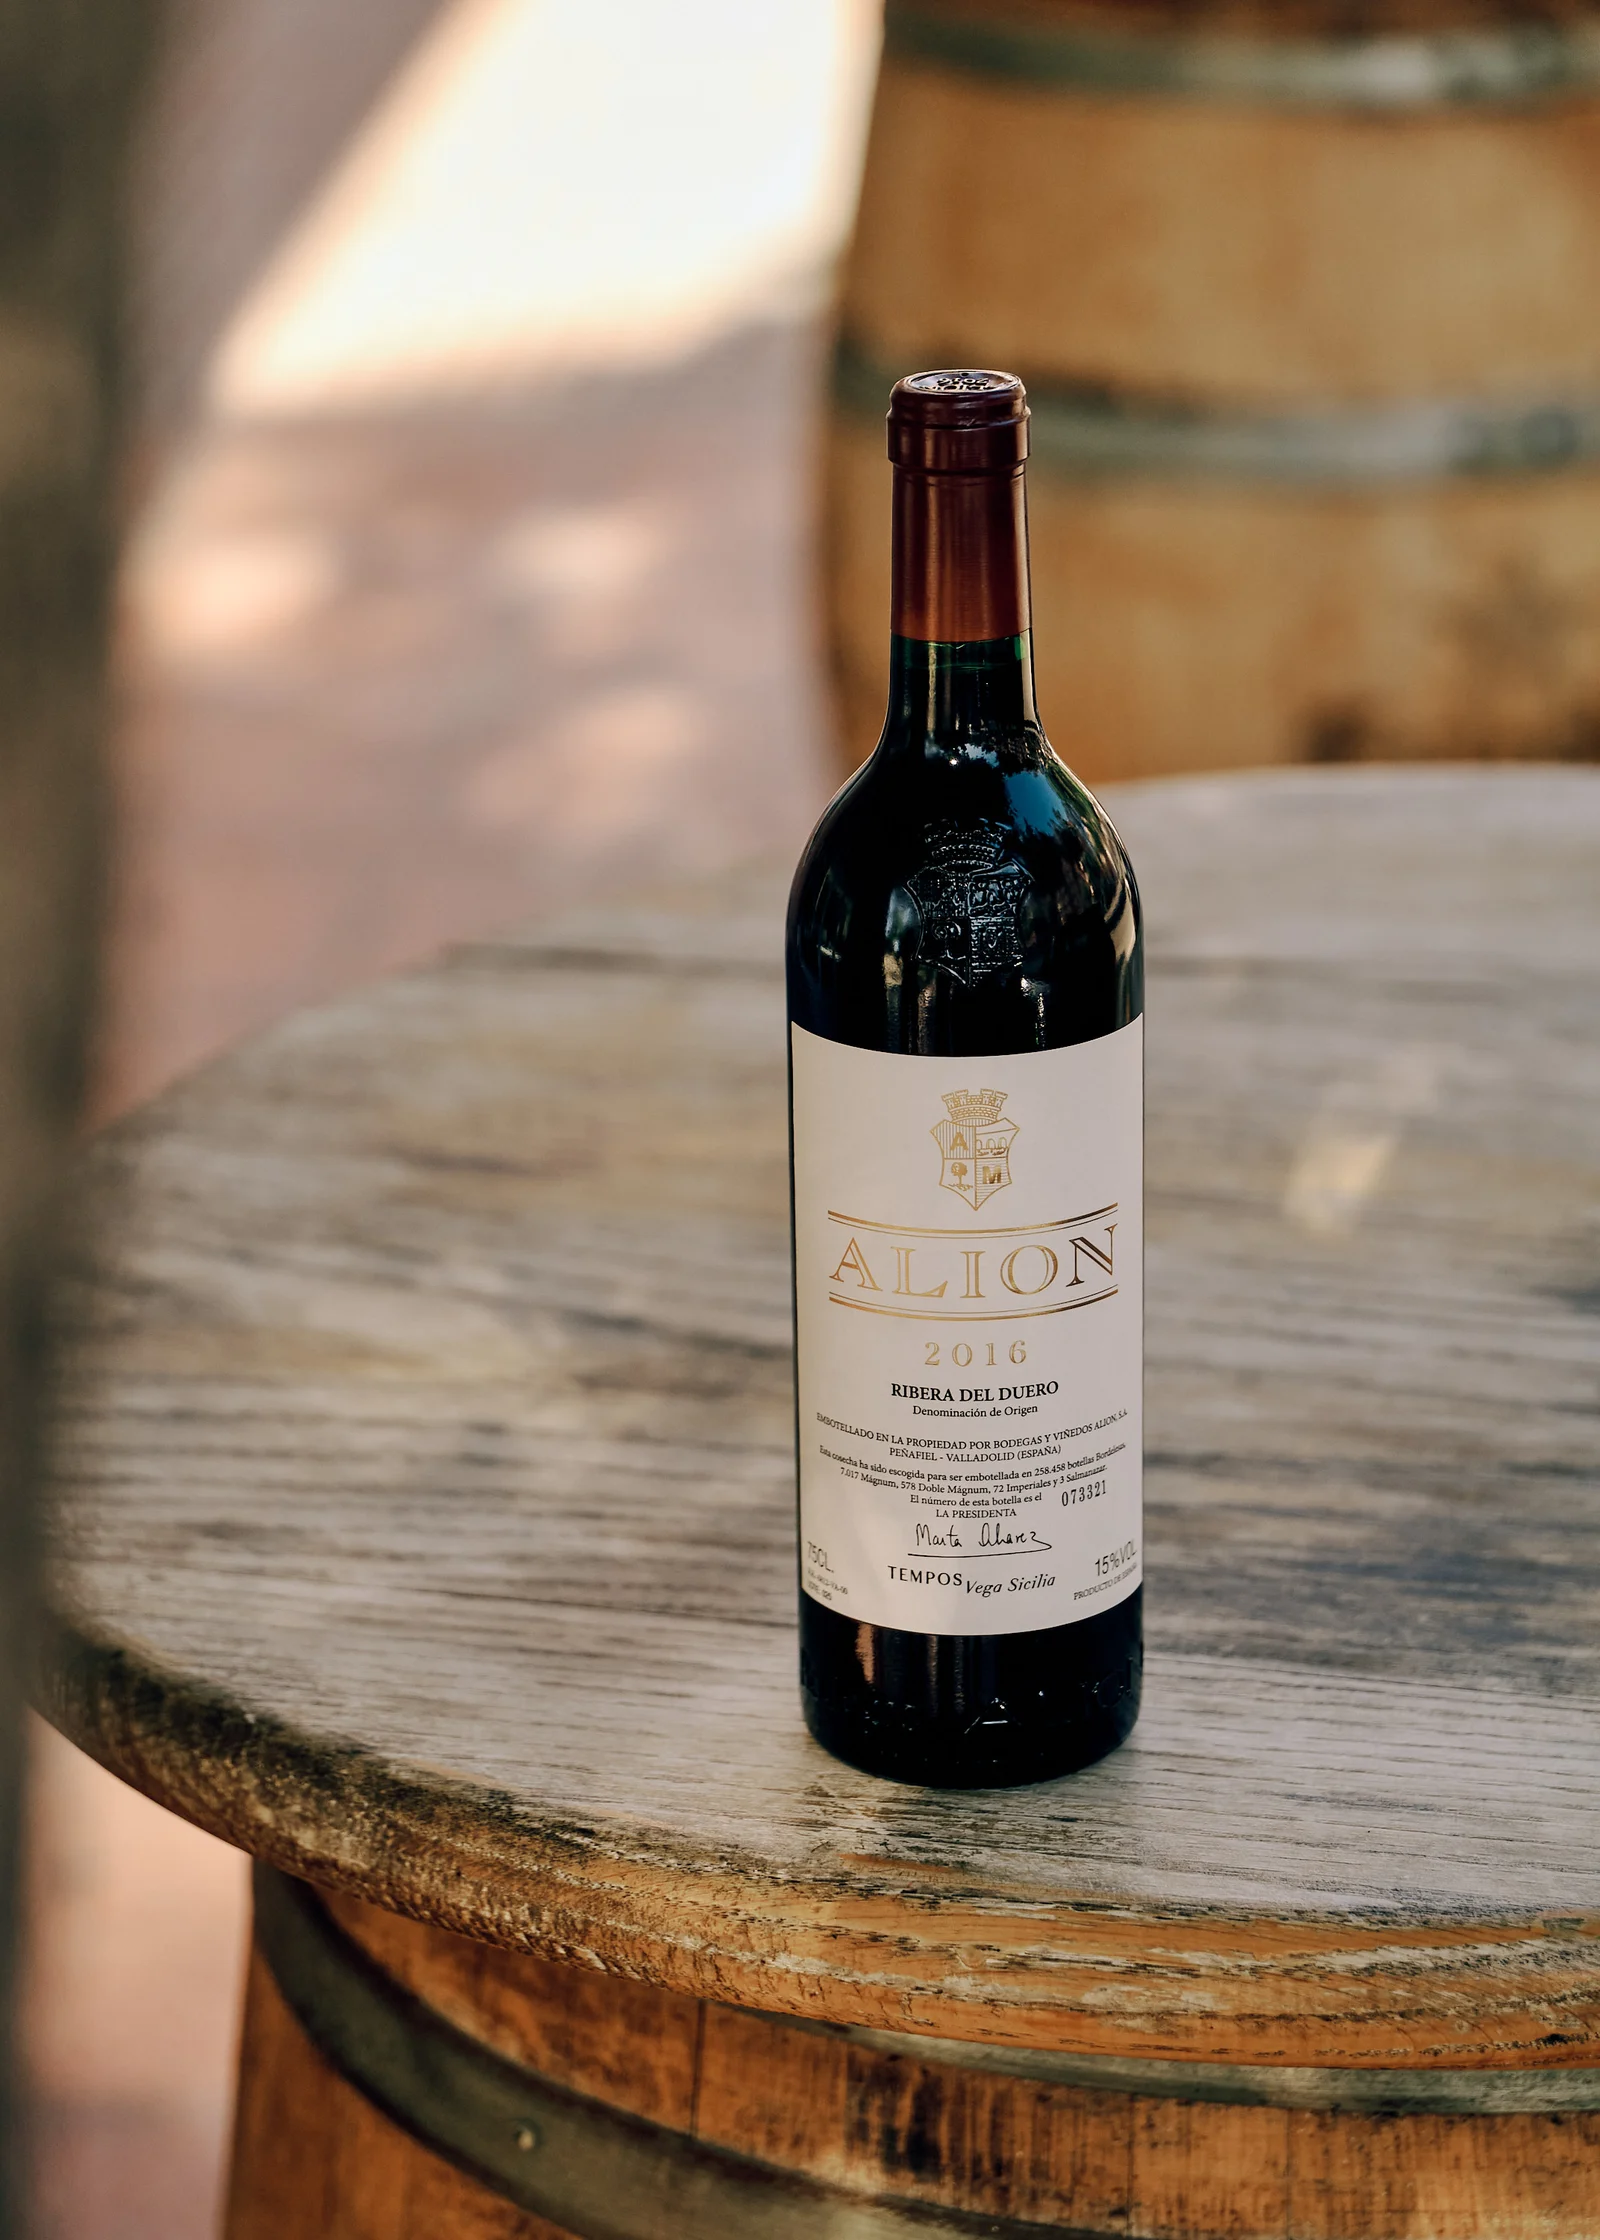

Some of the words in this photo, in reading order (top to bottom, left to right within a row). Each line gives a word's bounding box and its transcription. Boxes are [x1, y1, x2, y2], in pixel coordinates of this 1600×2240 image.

[950, 1132, 969, 1151] A
[983, 1166, 1002, 1184] M
[829, 1223, 1118, 1299] ALION
[924, 1341, 1027, 1367] 2016
[891, 1383, 955, 1402] RIBERA
[960, 1388, 994, 1402] DEL
[998, 1380, 1058, 1401] DUERO
[912, 1405, 986, 1418] Denominación
[990, 1407, 1002, 1416] de
[1004, 1404, 1038, 1418] Origen
[816, 1412, 874, 1440] EMBOTELLADO
[876, 1432, 889, 1442] EN
[892, 1435, 904, 1445] LA
[906, 1438, 966, 1450] PROPIEDAD
[970, 1440, 991, 1450] POR
[994, 1436, 1042, 1449] BODEGAS
[1044, 1433, 1052, 1443] Y
[1053, 1424, 1092, 1441] VIÑEDOS
[819, 1445, 832, 1458] Esta
[832, 1453, 858, 1467] cosecha
[859, 1460, 868, 1470] ha
[870, 1463, 887, 1474] sido
[889, 1468, 925, 1480] escogida
[928, 1472, 947, 1482] para
[949, 1474, 962, 1482] ser
[965, 1470, 1020, 1482] embotellada
[1034, 1463, 1066, 1476] 258.458
[1067, 1454, 1094, 1470] botellas
[889, 1447, 938, 1460] PEÑAFIEL
[947, 1452, 1014, 1462] VALLADOLID
[1017, 1445, 1062, 1460] (ESPAÑA)
[860, 1473, 899, 1488] Mágnum,
[900, 1481, 916, 1490] 578
[918, 1483, 945, 1494] Doble
[947, 1484, 991, 1496] Mágnum,
[1006, 1478, 1052, 1494] Imperiales
[1052, 1479, 1058, 1488] y
[1060, 1476, 1064, 1484] 3
[910, 1494, 918, 1504] El
[922, 1497, 956, 1506] número
[959, 1498, 970, 1506] de
[972, 1498, 990, 1506] esta
[992, 1496, 1022, 1506] botella
[1034, 1492, 1042, 1501] el
[1062, 1480, 1107, 1507] 073321
[936, 1509, 949, 1518] LA
[952, 1508, 1017, 1518] PRESIDENTA
[888, 1565, 963, 1586] TEMPOS
[966, 1580, 1003, 1598] Vega
[1008, 1574, 1056, 1592] Sicilia
[1073, 1579, 1113, 1600] PRODUCTO
